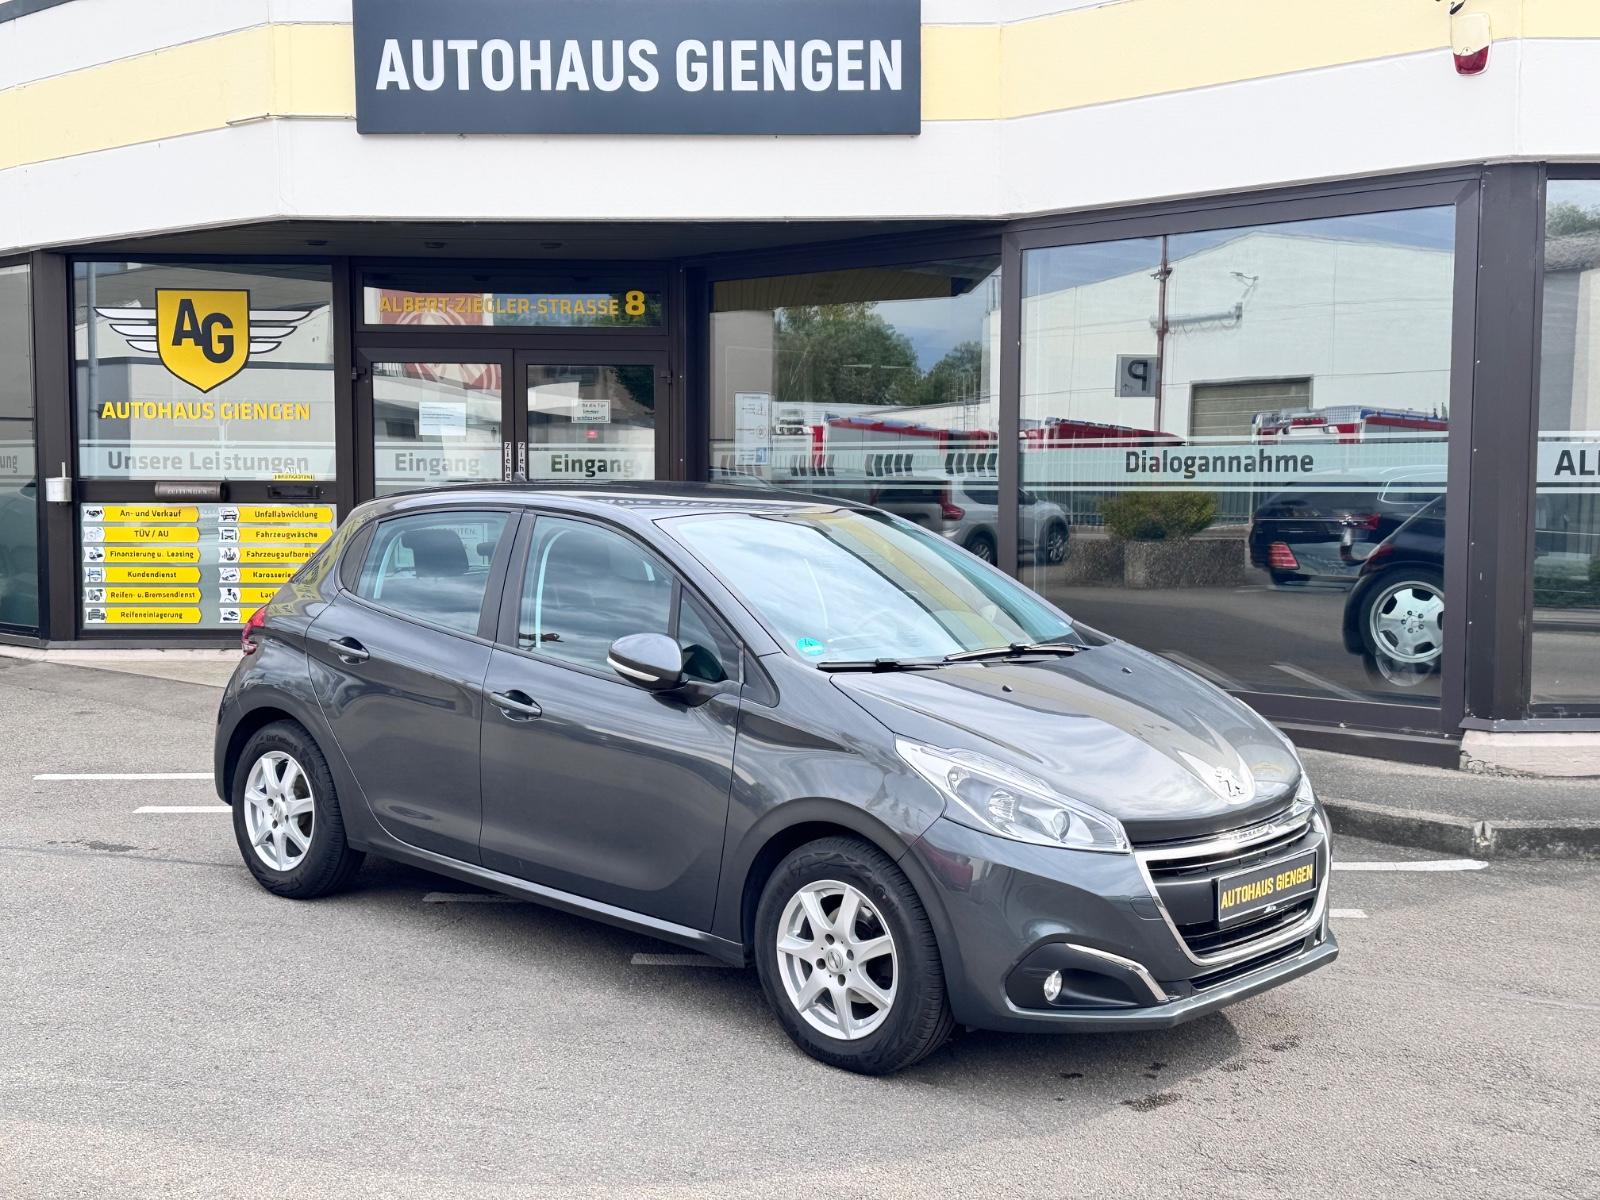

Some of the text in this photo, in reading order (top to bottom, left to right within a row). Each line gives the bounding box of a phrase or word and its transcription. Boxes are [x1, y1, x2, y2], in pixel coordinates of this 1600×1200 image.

[375, 39, 902, 92] AUTOHAUS GIENGEN
[379, 290, 646, 316] ALBERT-ZIEGLER-STRASSE 8
[172, 299, 234, 363] AG
[101, 402, 311, 421] AUTOHAUS GIENGEN
[108, 451, 309, 473] Unsere Leistungen
[395, 453, 480, 476] Eingang
[551, 454, 634, 477] Eingang
[1125, 450, 1314, 479] Dialogannahme
[1554, 449, 1600, 476] AL
[135, 509, 150, 517] und
[152, 509, 182, 517] Verkauf
[255, 510, 318, 519] Unfallabwicklung
[256, 531, 318, 539] Fahrzeugwäsche
[110, 550, 156, 558] Finanzierung
[166, 550, 194, 558] Leasing
[121, 611, 183, 619] Reifeneinlagerung
[1221, 863, 1313, 910] AUTOHAUS GIENGEN
